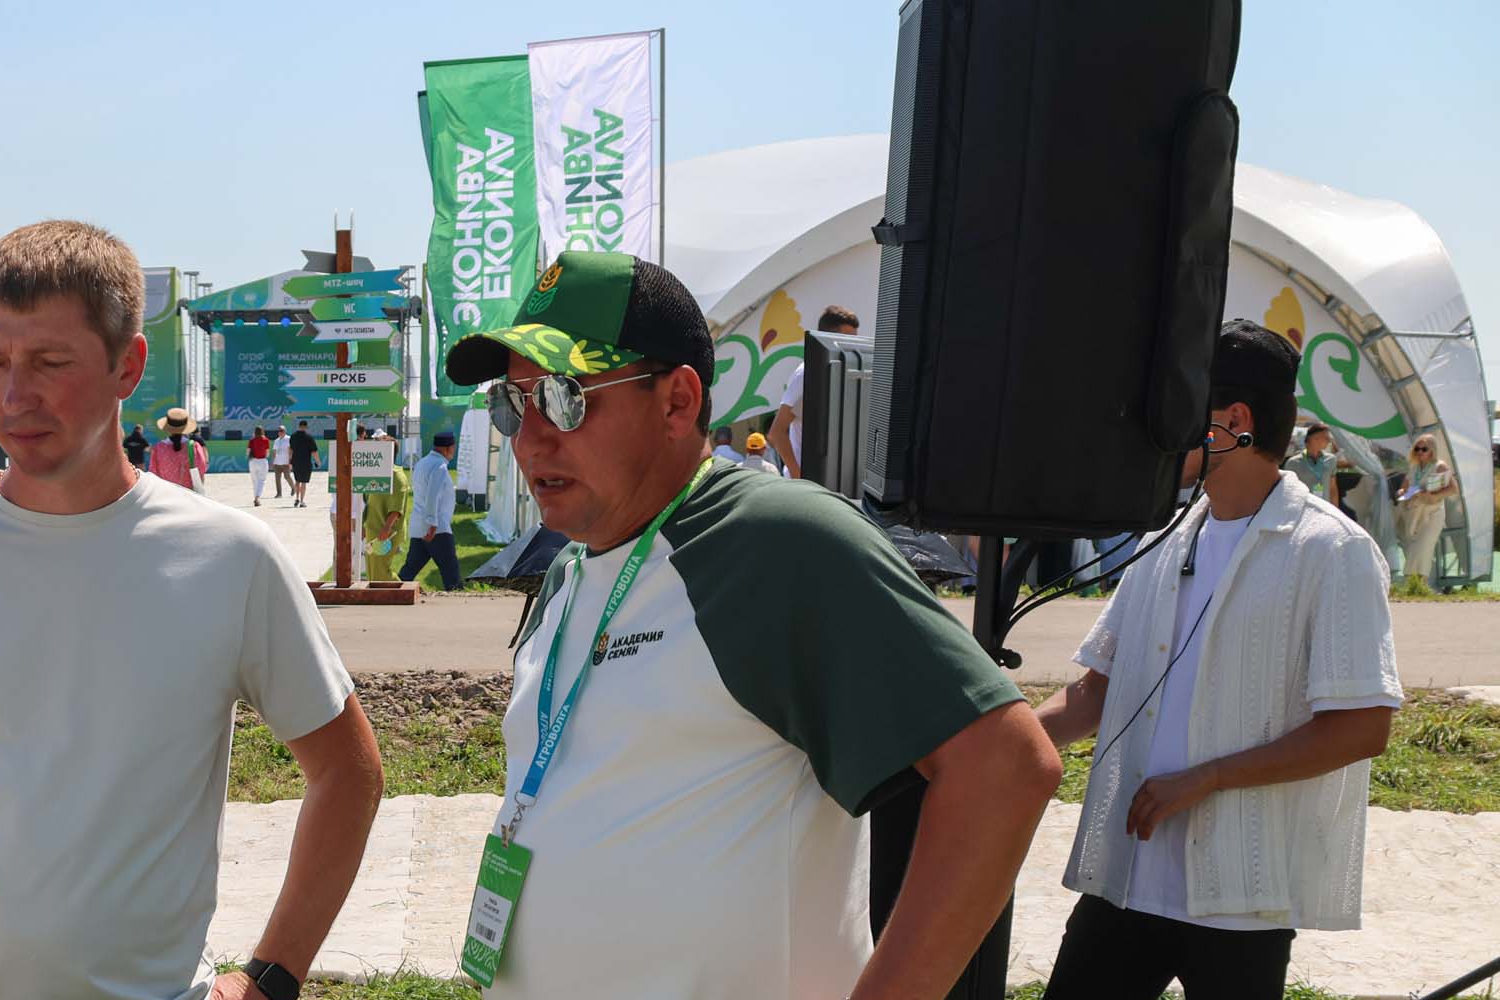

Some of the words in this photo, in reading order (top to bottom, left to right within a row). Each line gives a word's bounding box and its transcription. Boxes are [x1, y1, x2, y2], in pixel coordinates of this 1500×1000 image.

[343, 303, 357, 313] WC
[278, 353, 337, 362] МЕЖДУНАРО
[330, 373, 366, 383] РСХБ
[604, 553, 643, 618] АГРОВОЛГА
[611, 630, 664, 649] АКАДЕМИЯ
[607, 645, 639, 660] СЕМЯН
[534, 703, 571, 769] АГРОВОЛГА
